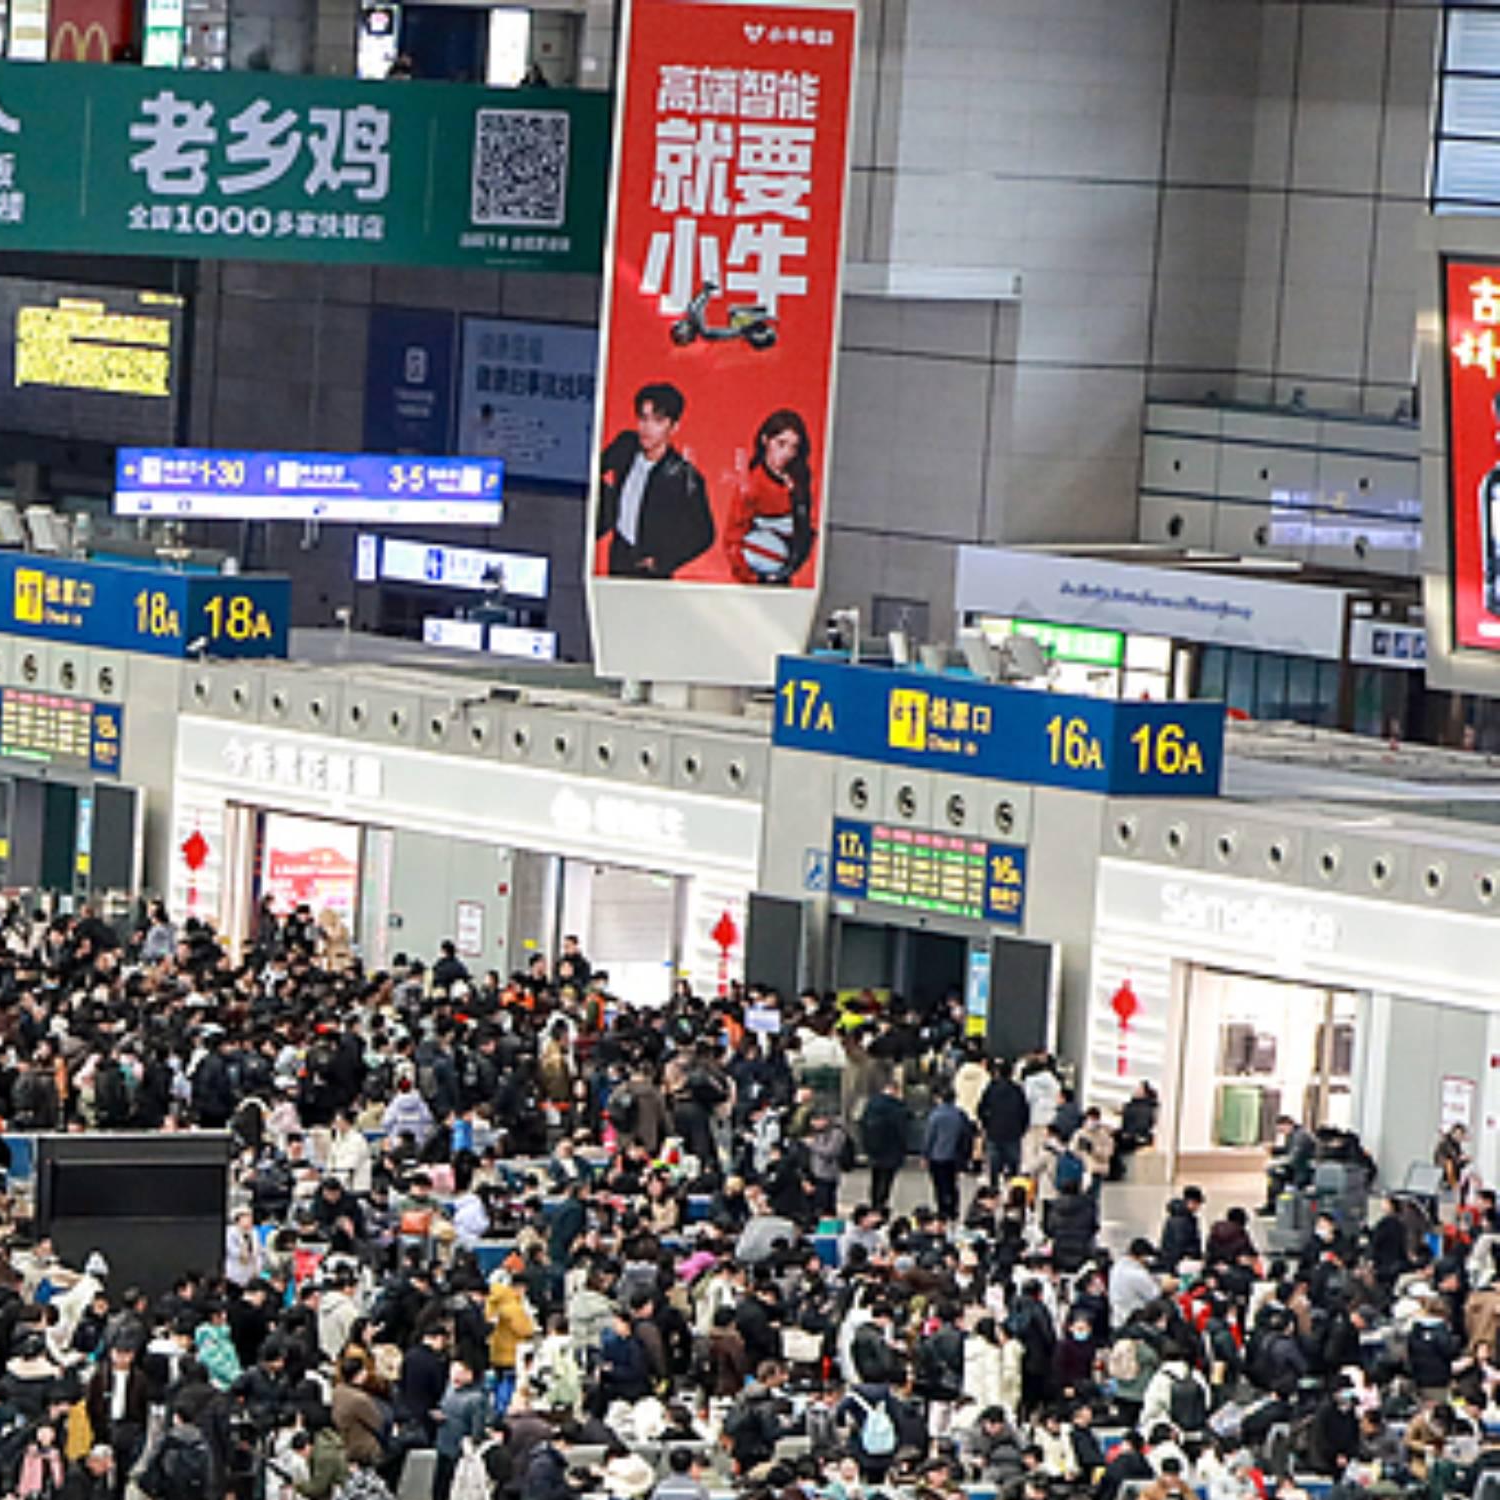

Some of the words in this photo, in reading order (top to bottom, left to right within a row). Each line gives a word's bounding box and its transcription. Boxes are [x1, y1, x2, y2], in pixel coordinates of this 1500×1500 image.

[656, 65, 821, 121] 高端智能
[128, 90, 391, 201] 老乡鸡
[652, 118, 816, 219] 就要
[639, 219, 808, 318] 小牛
[135, 591, 181, 638] 18A
[204, 595, 273, 640] 18A
[780, 679, 835, 734] 17A
[1046, 715, 1104, 771] 16A
[1131, 724, 1204, 776] 16A
